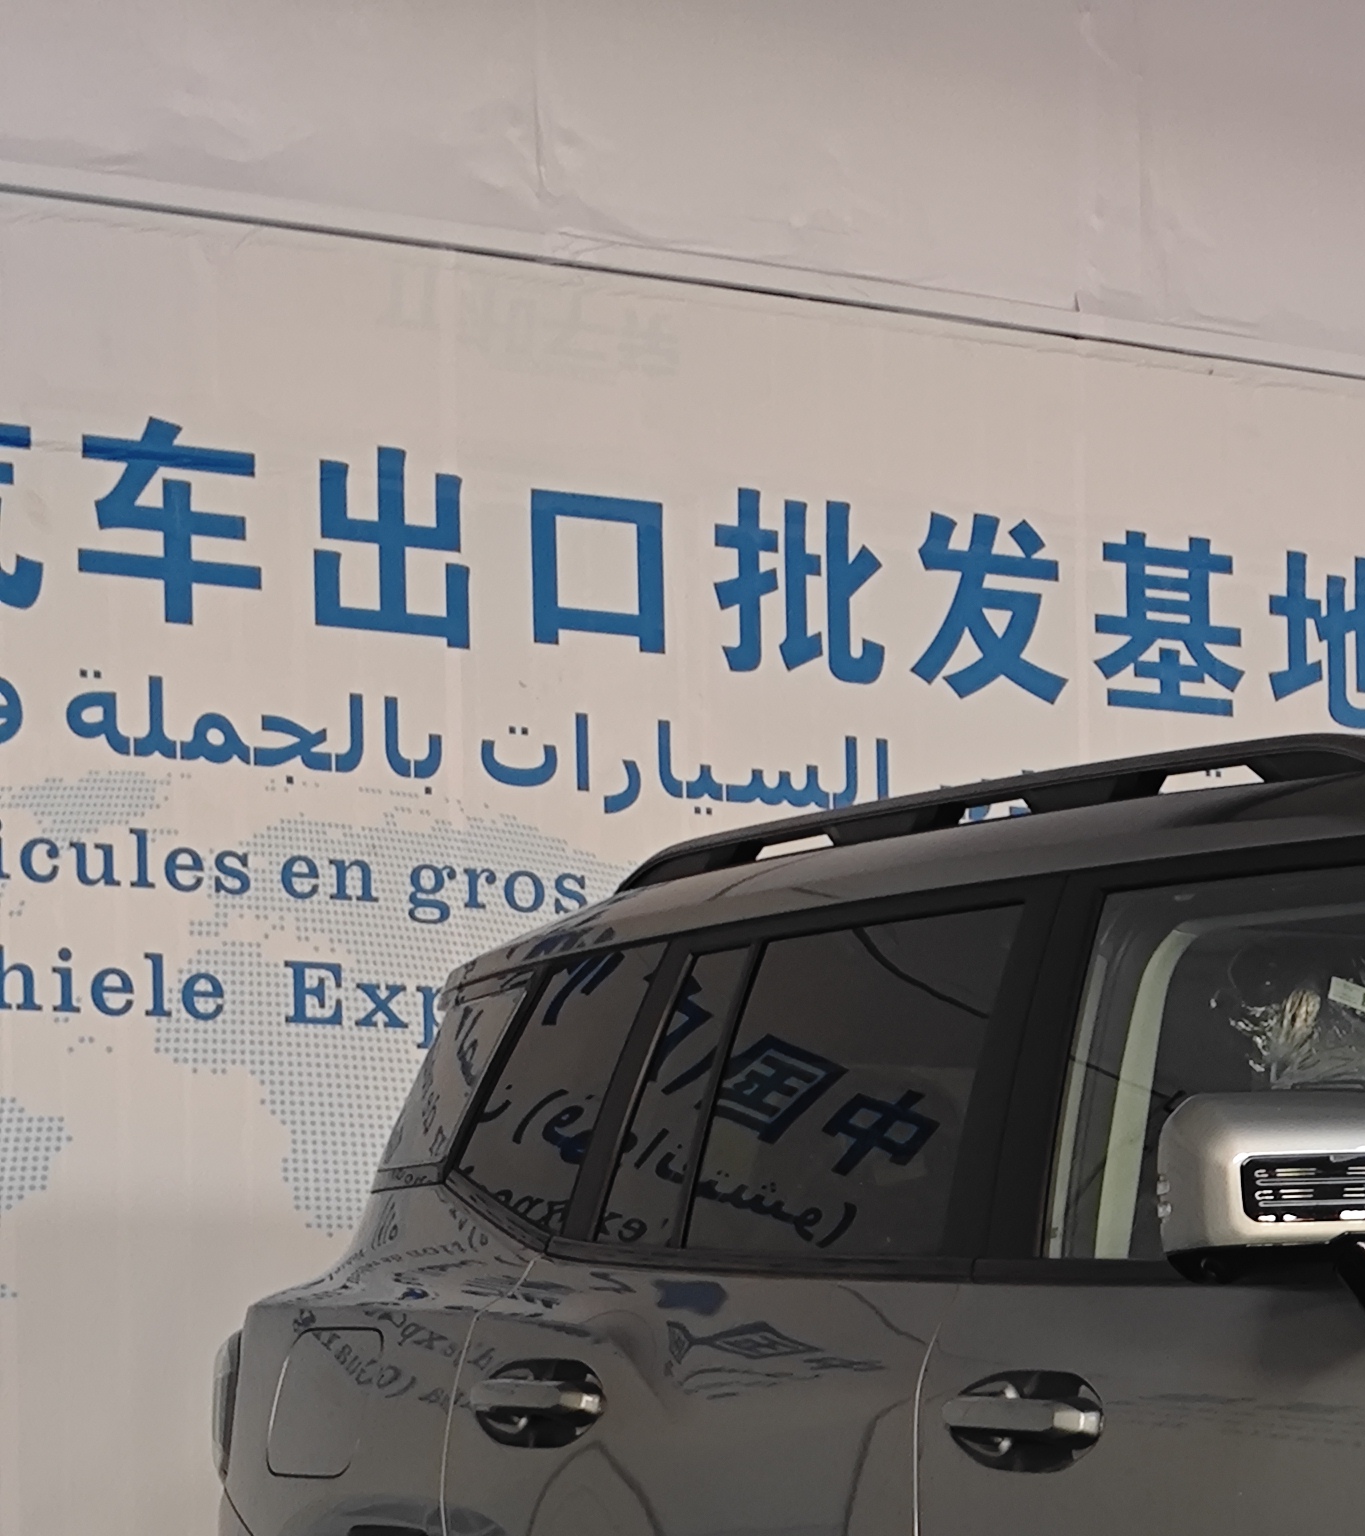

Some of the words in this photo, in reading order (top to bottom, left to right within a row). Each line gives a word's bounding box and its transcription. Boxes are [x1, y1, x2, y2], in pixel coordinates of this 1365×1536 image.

[65, 668, 443, 795] بالجملة
[480, 712, 889, 815] السيارات
[280, 854, 379, 903] en
[407, 863, 588, 925] gros
